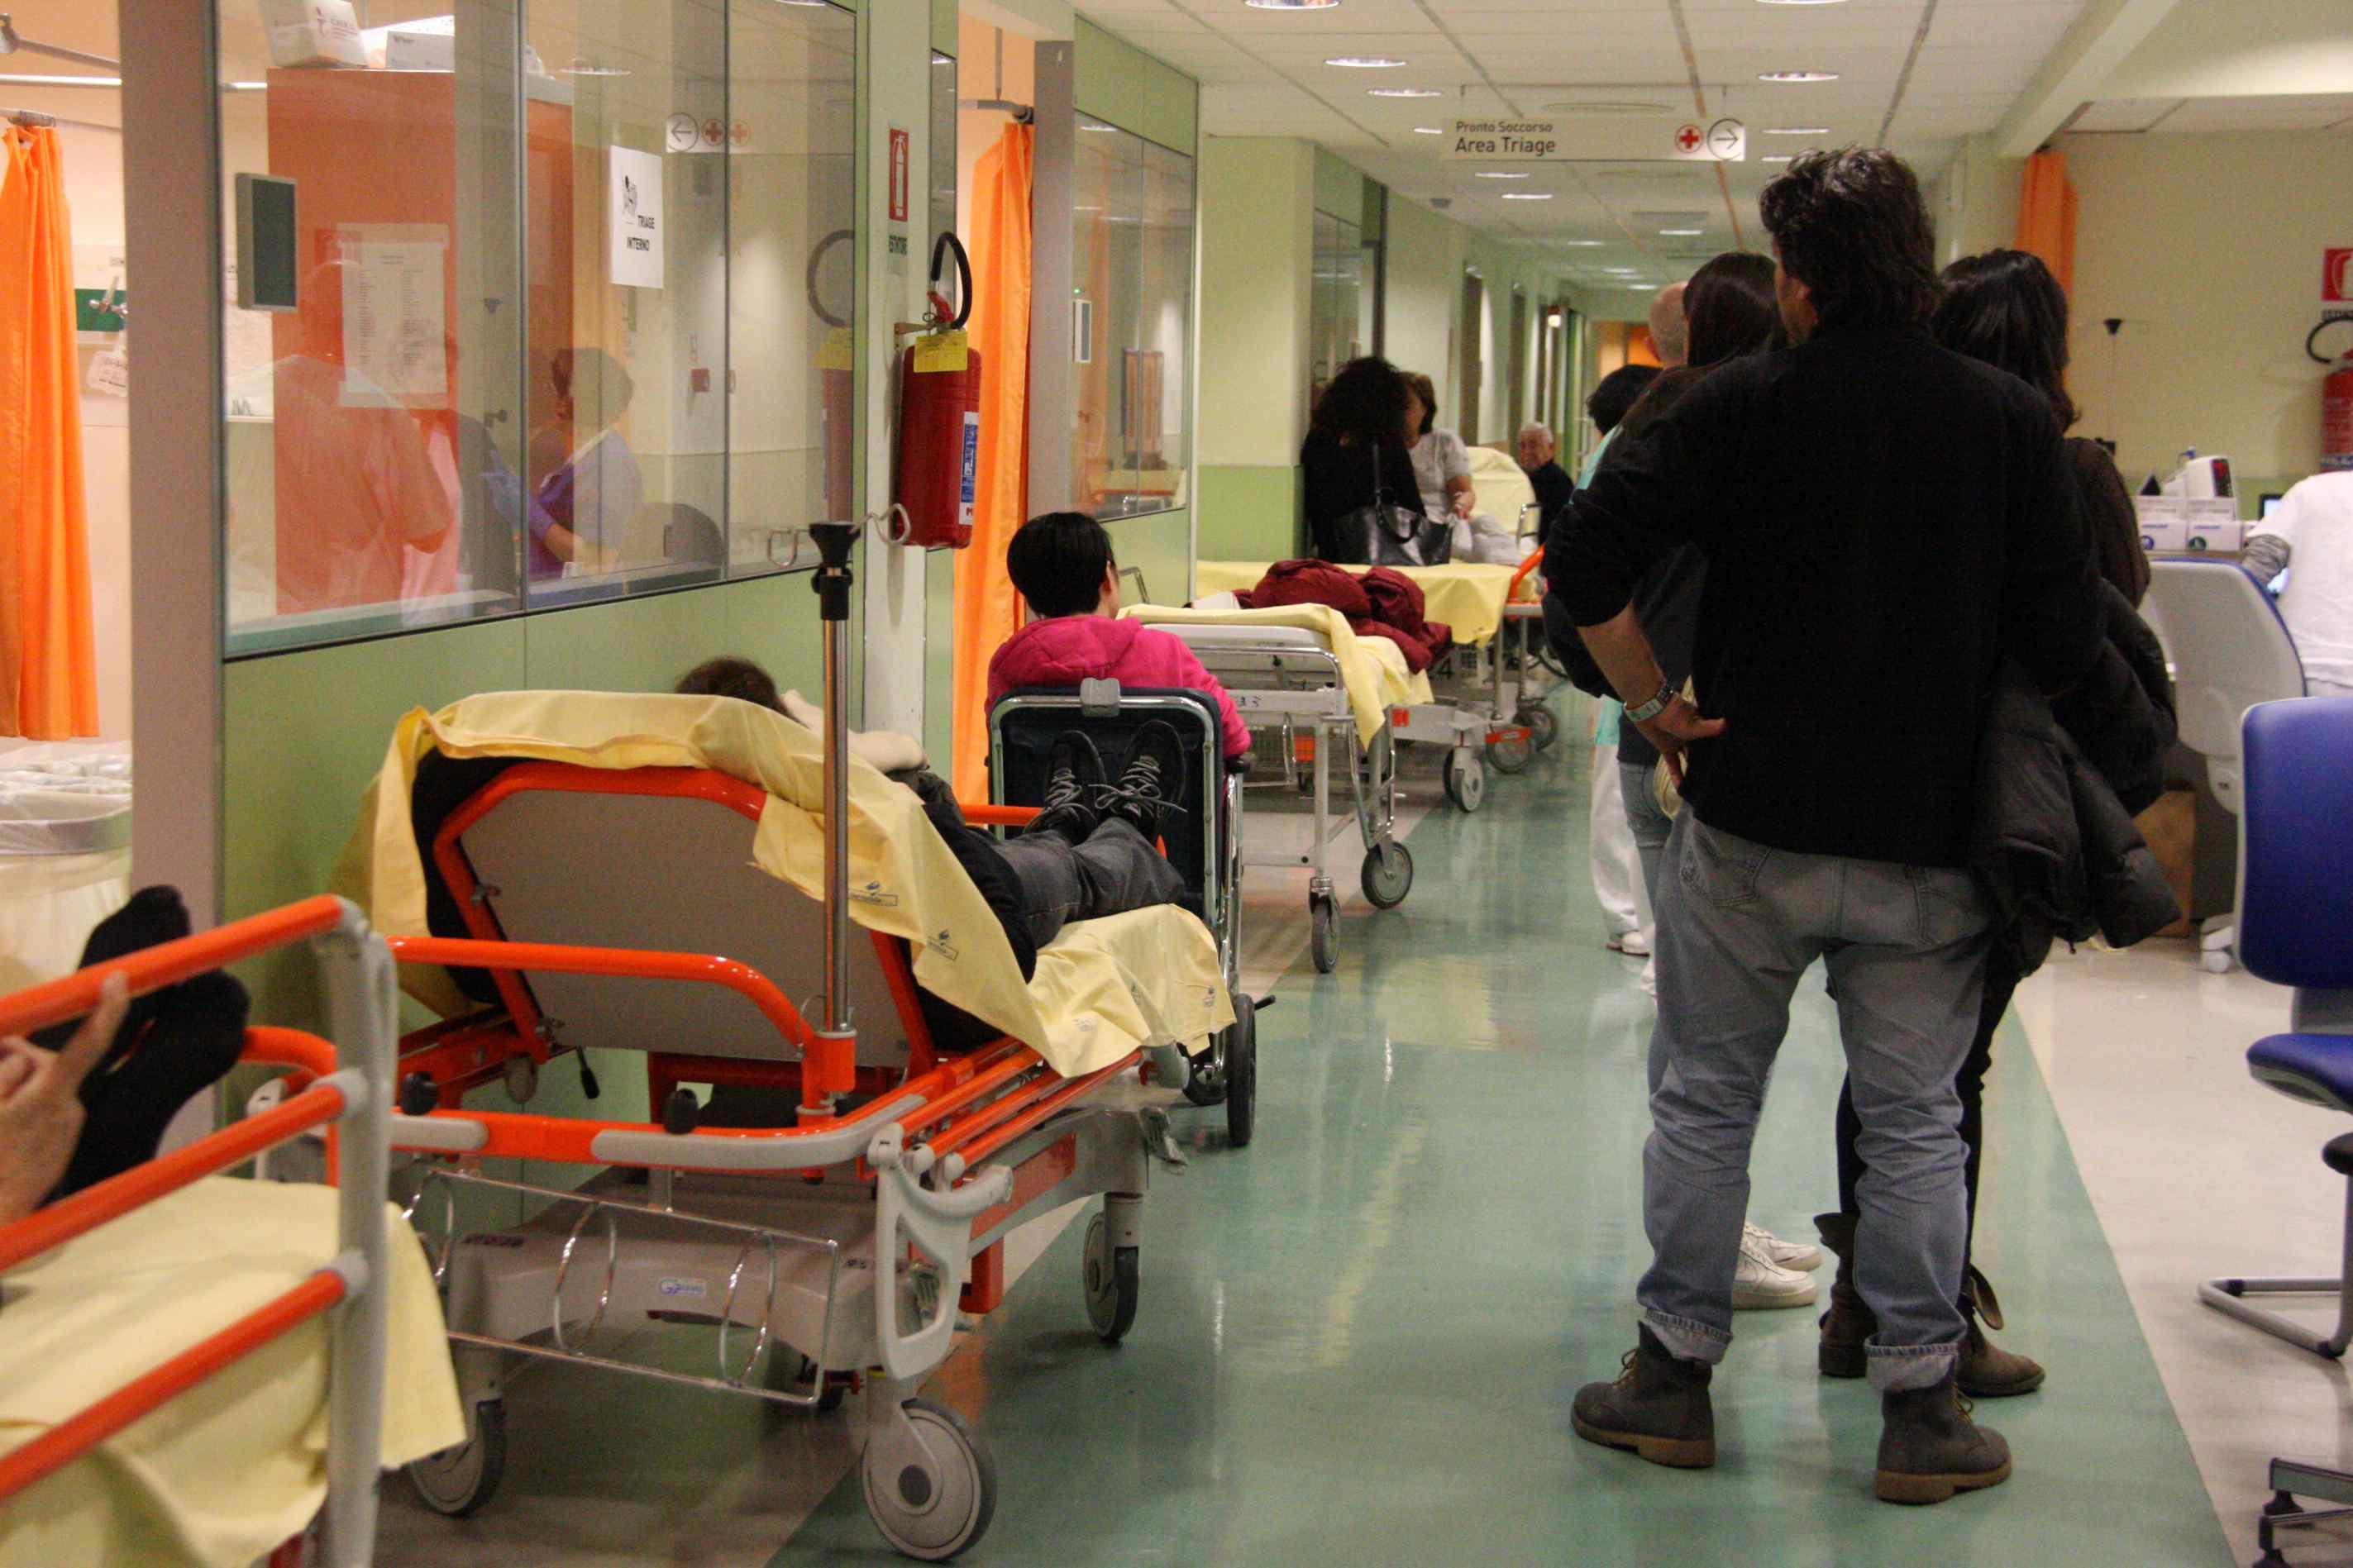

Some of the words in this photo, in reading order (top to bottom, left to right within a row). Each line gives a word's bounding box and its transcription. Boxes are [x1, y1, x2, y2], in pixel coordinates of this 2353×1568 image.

[1455, 121, 1496, 133] Pronto
[1498, 122, 1553, 133] Soccorso
[1455, 137, 1495, 153] Area
[1501, 136, 1555, 156] Triage
[637, 215, 655, 230] TRIAGE
